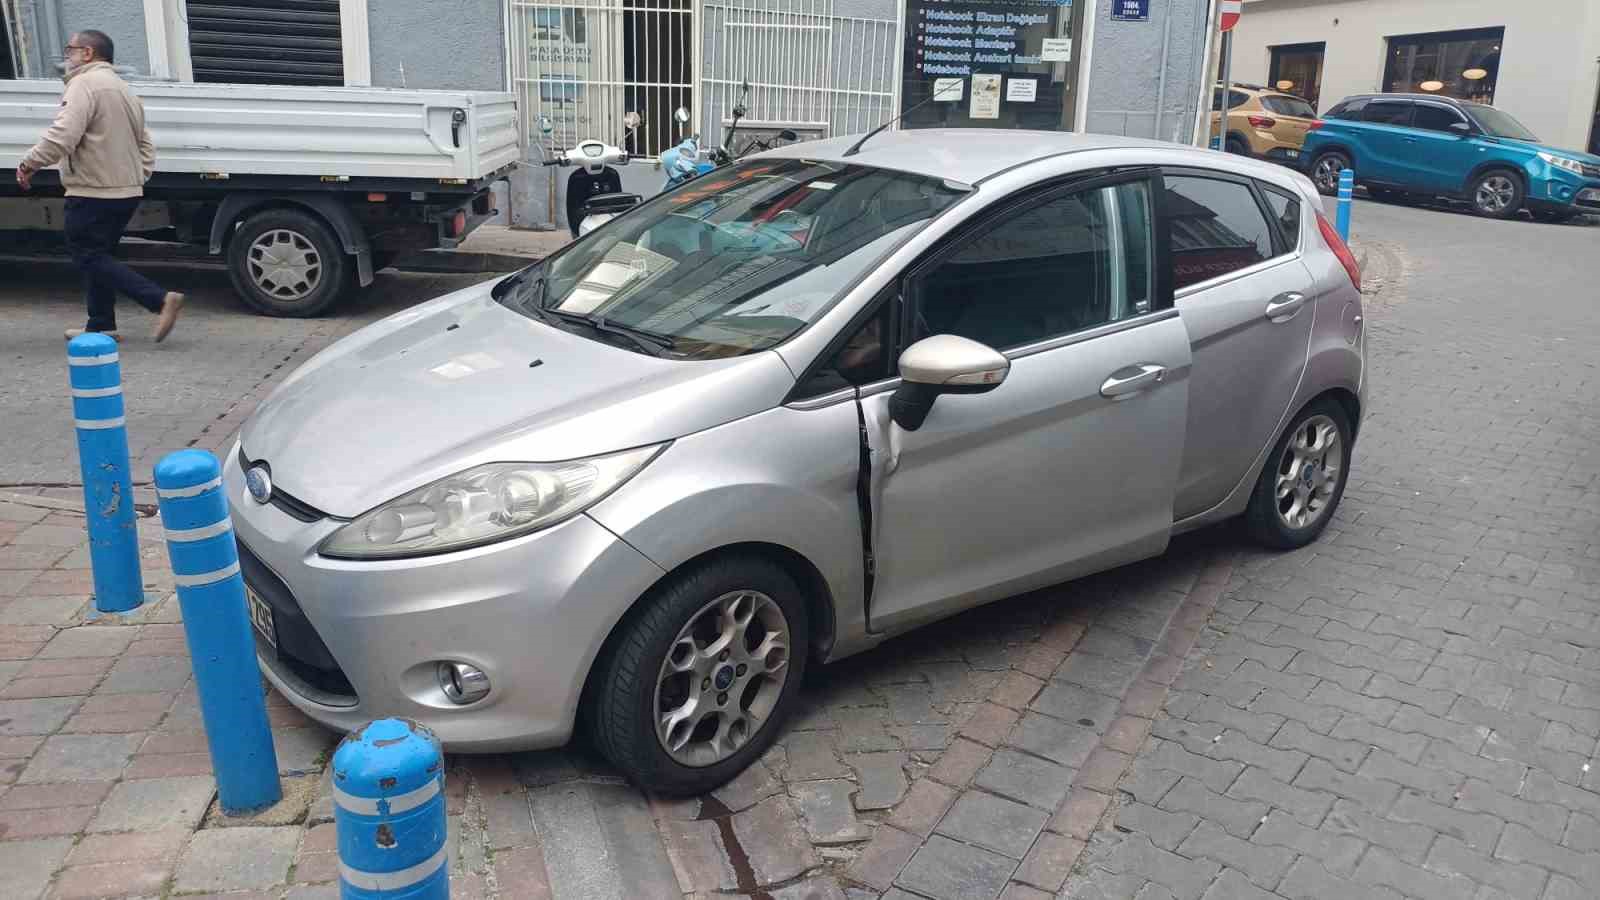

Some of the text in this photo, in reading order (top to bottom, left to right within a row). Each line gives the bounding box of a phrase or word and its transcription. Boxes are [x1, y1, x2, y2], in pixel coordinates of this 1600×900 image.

[926, 9, 974, 21] Notebook
[976, 11, 1005, 22] Ekran
[925, 23, 1016, 37] Notebook Adaptör
[925, 36, 972, 48] Notebook
[924, 50, 972, 62] Notebook
[973, 52, 1012, 63] Anakart
[923, 63, 971, 75] Notebook
